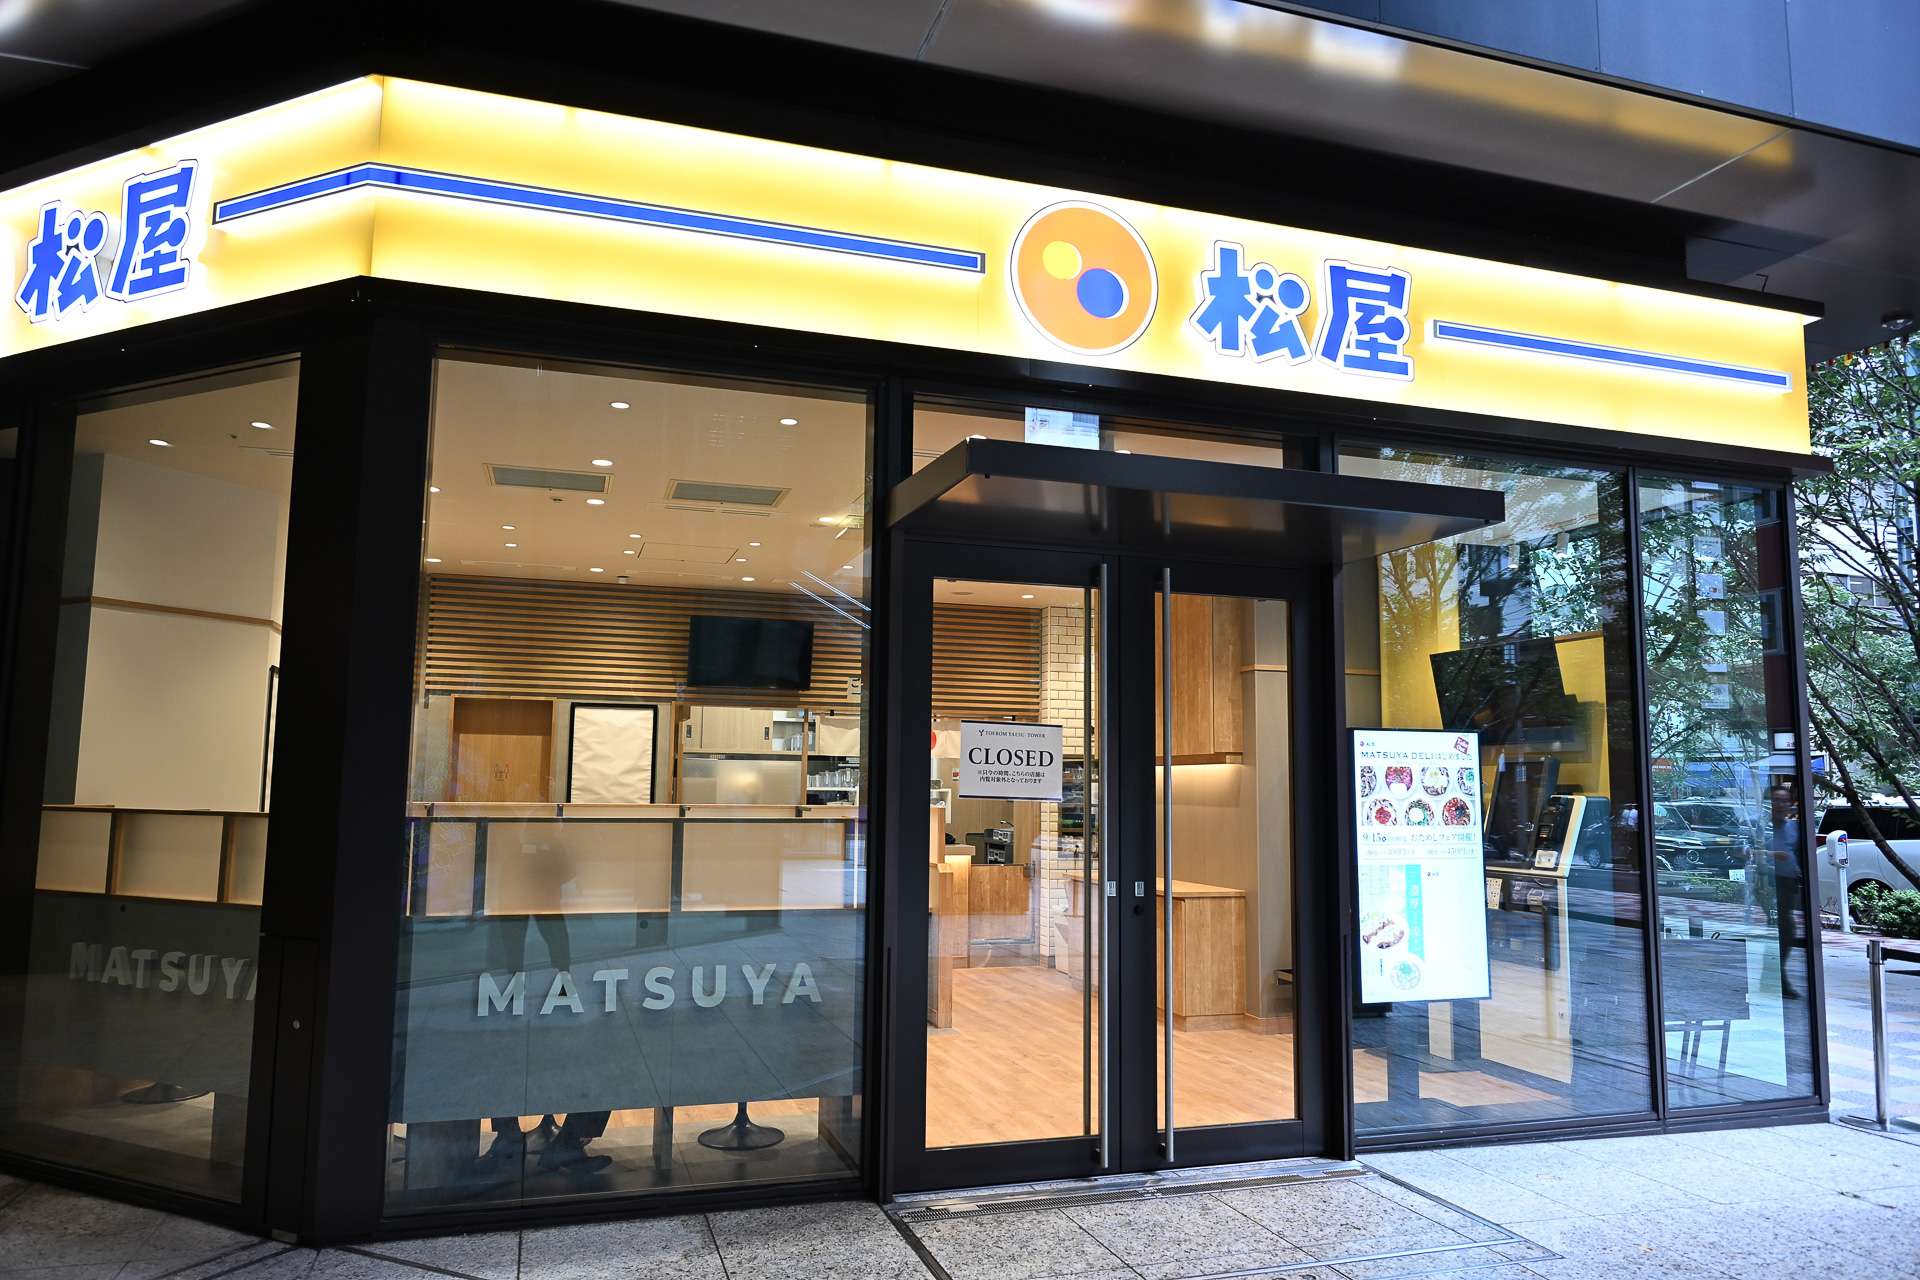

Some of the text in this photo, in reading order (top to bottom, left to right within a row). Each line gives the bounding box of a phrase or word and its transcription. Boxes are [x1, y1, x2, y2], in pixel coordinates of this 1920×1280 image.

[17, 161, 197, 321] 松屋
[1193, 243, 1412, 380] 松屋
[968, 747, 1054, 768] CLOSED
[1361, 751, 1408, 759] MATSUYA
[979, 776, 1042, 784] 内覧対象外となっております
[477, 962, 823, 1017] MATSUYA
